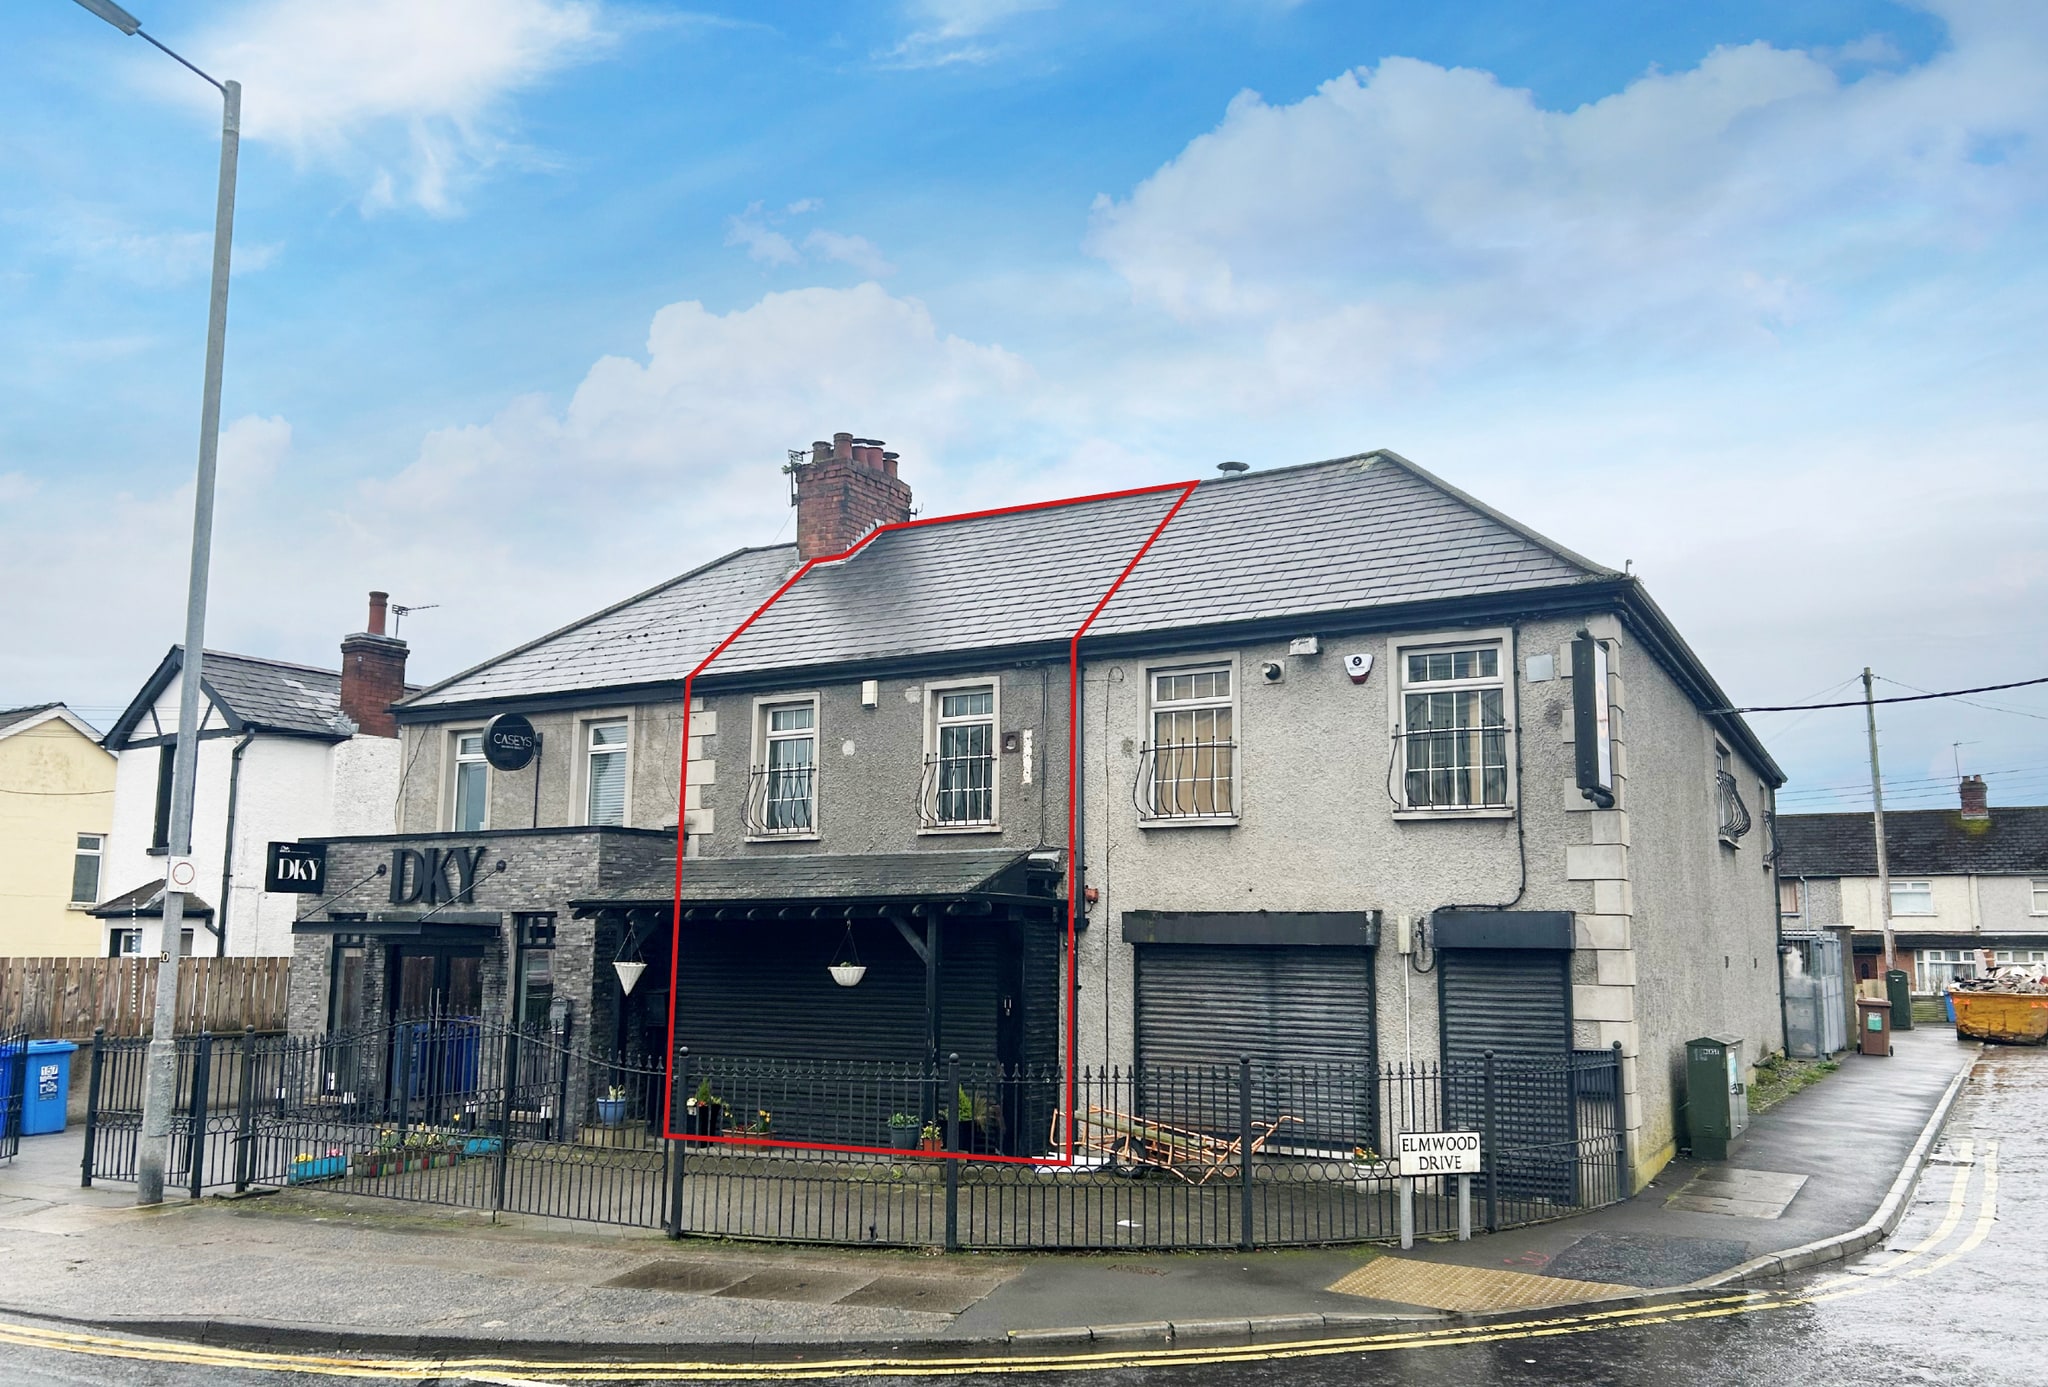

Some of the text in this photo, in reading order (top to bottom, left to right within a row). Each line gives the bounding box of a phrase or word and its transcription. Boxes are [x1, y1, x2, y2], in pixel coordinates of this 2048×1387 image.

[493, 733, 532, 747] CASEYS
[278, 857, 321, 880] DKY
[388, 846, 486, 904] DKY
[1402, 1136, 1478, 1152] ELMWOOD
[1419, 1155, 1462, 1170] DRIVE
